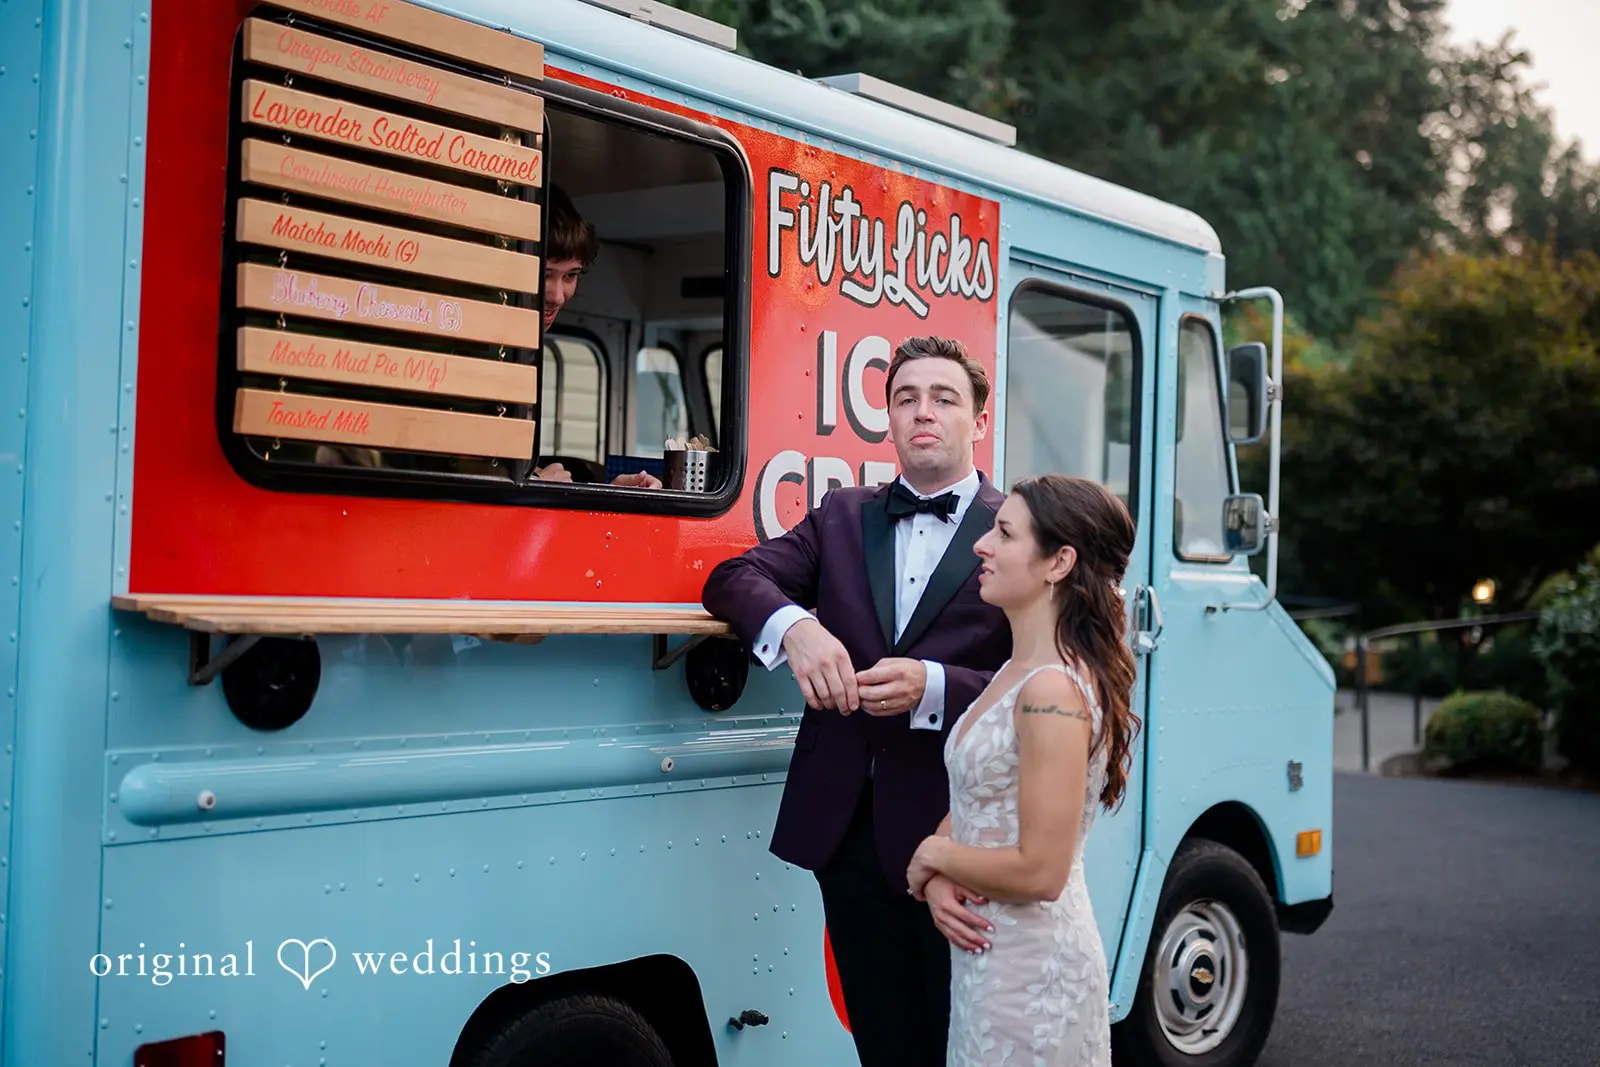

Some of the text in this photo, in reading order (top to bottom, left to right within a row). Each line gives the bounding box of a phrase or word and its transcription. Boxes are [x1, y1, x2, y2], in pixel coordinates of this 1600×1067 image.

[277, 29, 441, 104] Oregon Strawberry
[251, 89, 539, 182] Lavender Salted Caramel
[280, 154, 469, 216] Cornbread Honeybutter
[271, 213, 419, 264] Matcha Mochi (G)
[768, 166, 995, 320] Fifty Licks
[270, 271, 463, 332] Blueberry Cheesecake (G)
[269, 339, 327, 369] Mocha
[331, 347, 372, 374] Mud
[373, 352, 399, 378] Pie
[816, 330, 892, 444] IC
[267, 401, 371, 435] Toasted Milk
